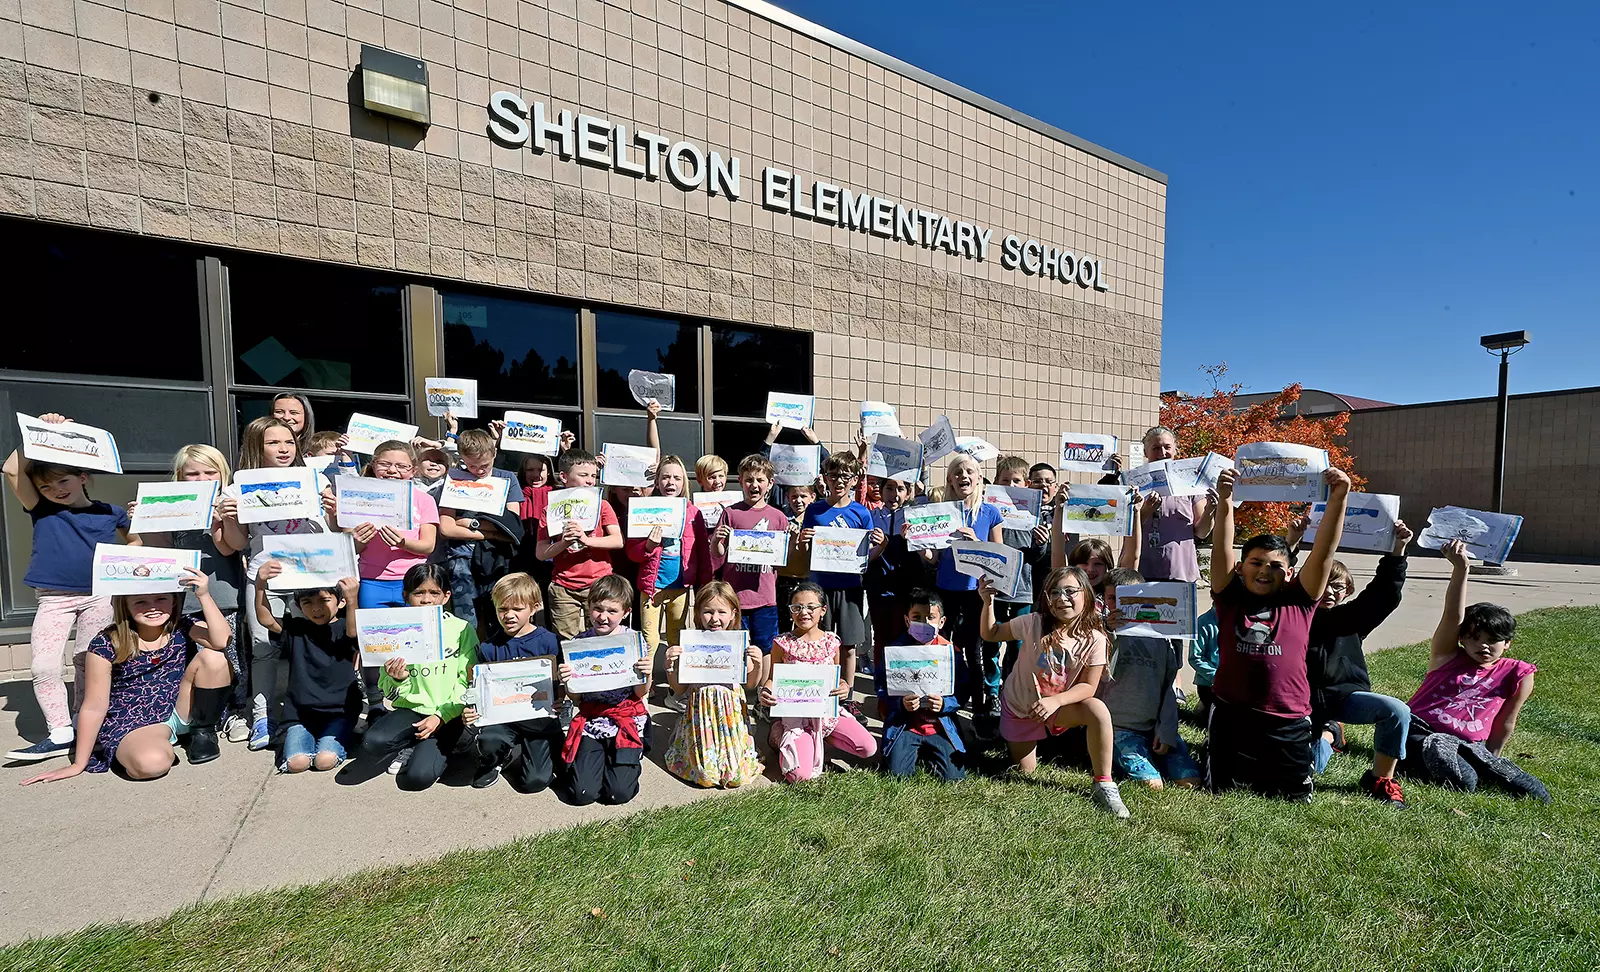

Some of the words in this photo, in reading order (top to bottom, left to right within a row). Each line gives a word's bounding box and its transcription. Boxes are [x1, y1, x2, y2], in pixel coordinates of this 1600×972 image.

[487, 90, 740, 199] SHELTON
[763, 166, 993, 261] ELEMENTARY
[1001, 235, 1109, 293] SCHOOL
[1236, 642, 1282, 656] SHELTON
[1119, 657, 1158, 668] addas
